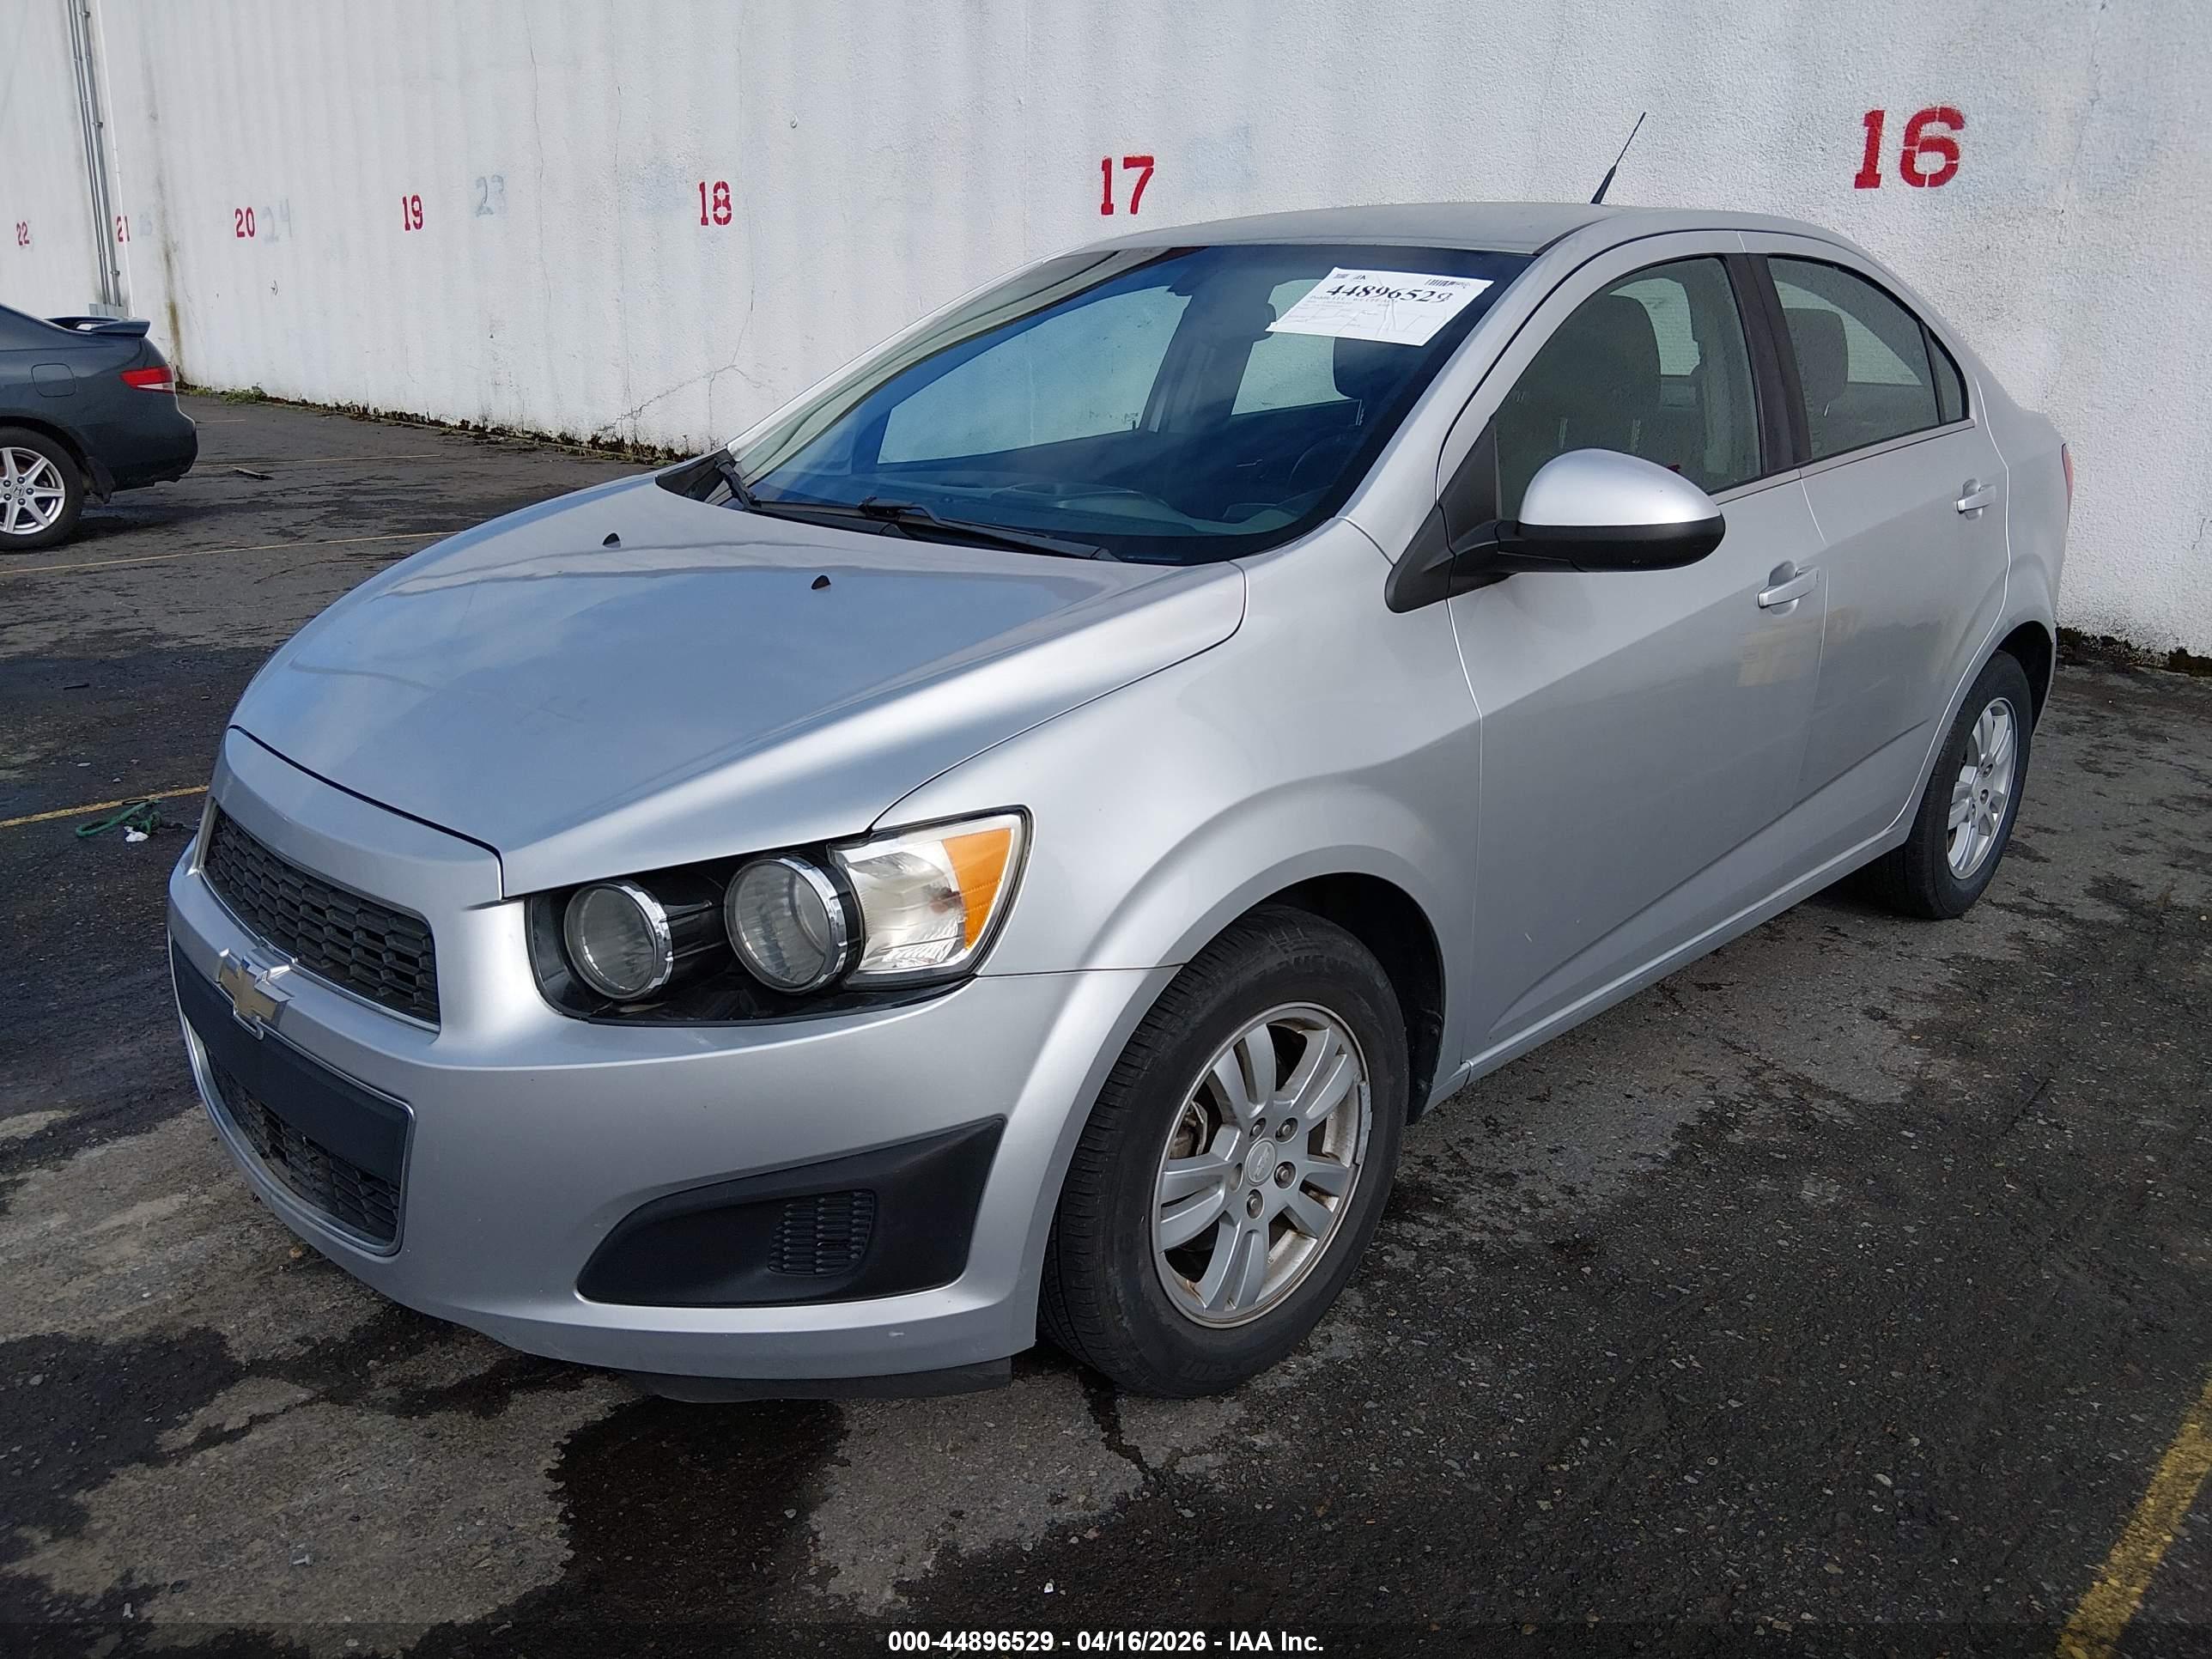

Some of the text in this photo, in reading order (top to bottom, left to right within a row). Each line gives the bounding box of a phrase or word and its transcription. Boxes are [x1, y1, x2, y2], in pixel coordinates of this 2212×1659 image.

[1854, 106, 1966, 189] 16
[1100, 155, 1155, 216] 17
[402, 194, 424, 232] 19
[698, 180, 732, 227] 18
[15, 221, 31, 246] 22
[116, 215, 131, 243] 21
[234, 206, 256, 239] 20
[1326, 284, 1454, 303] 44896529
